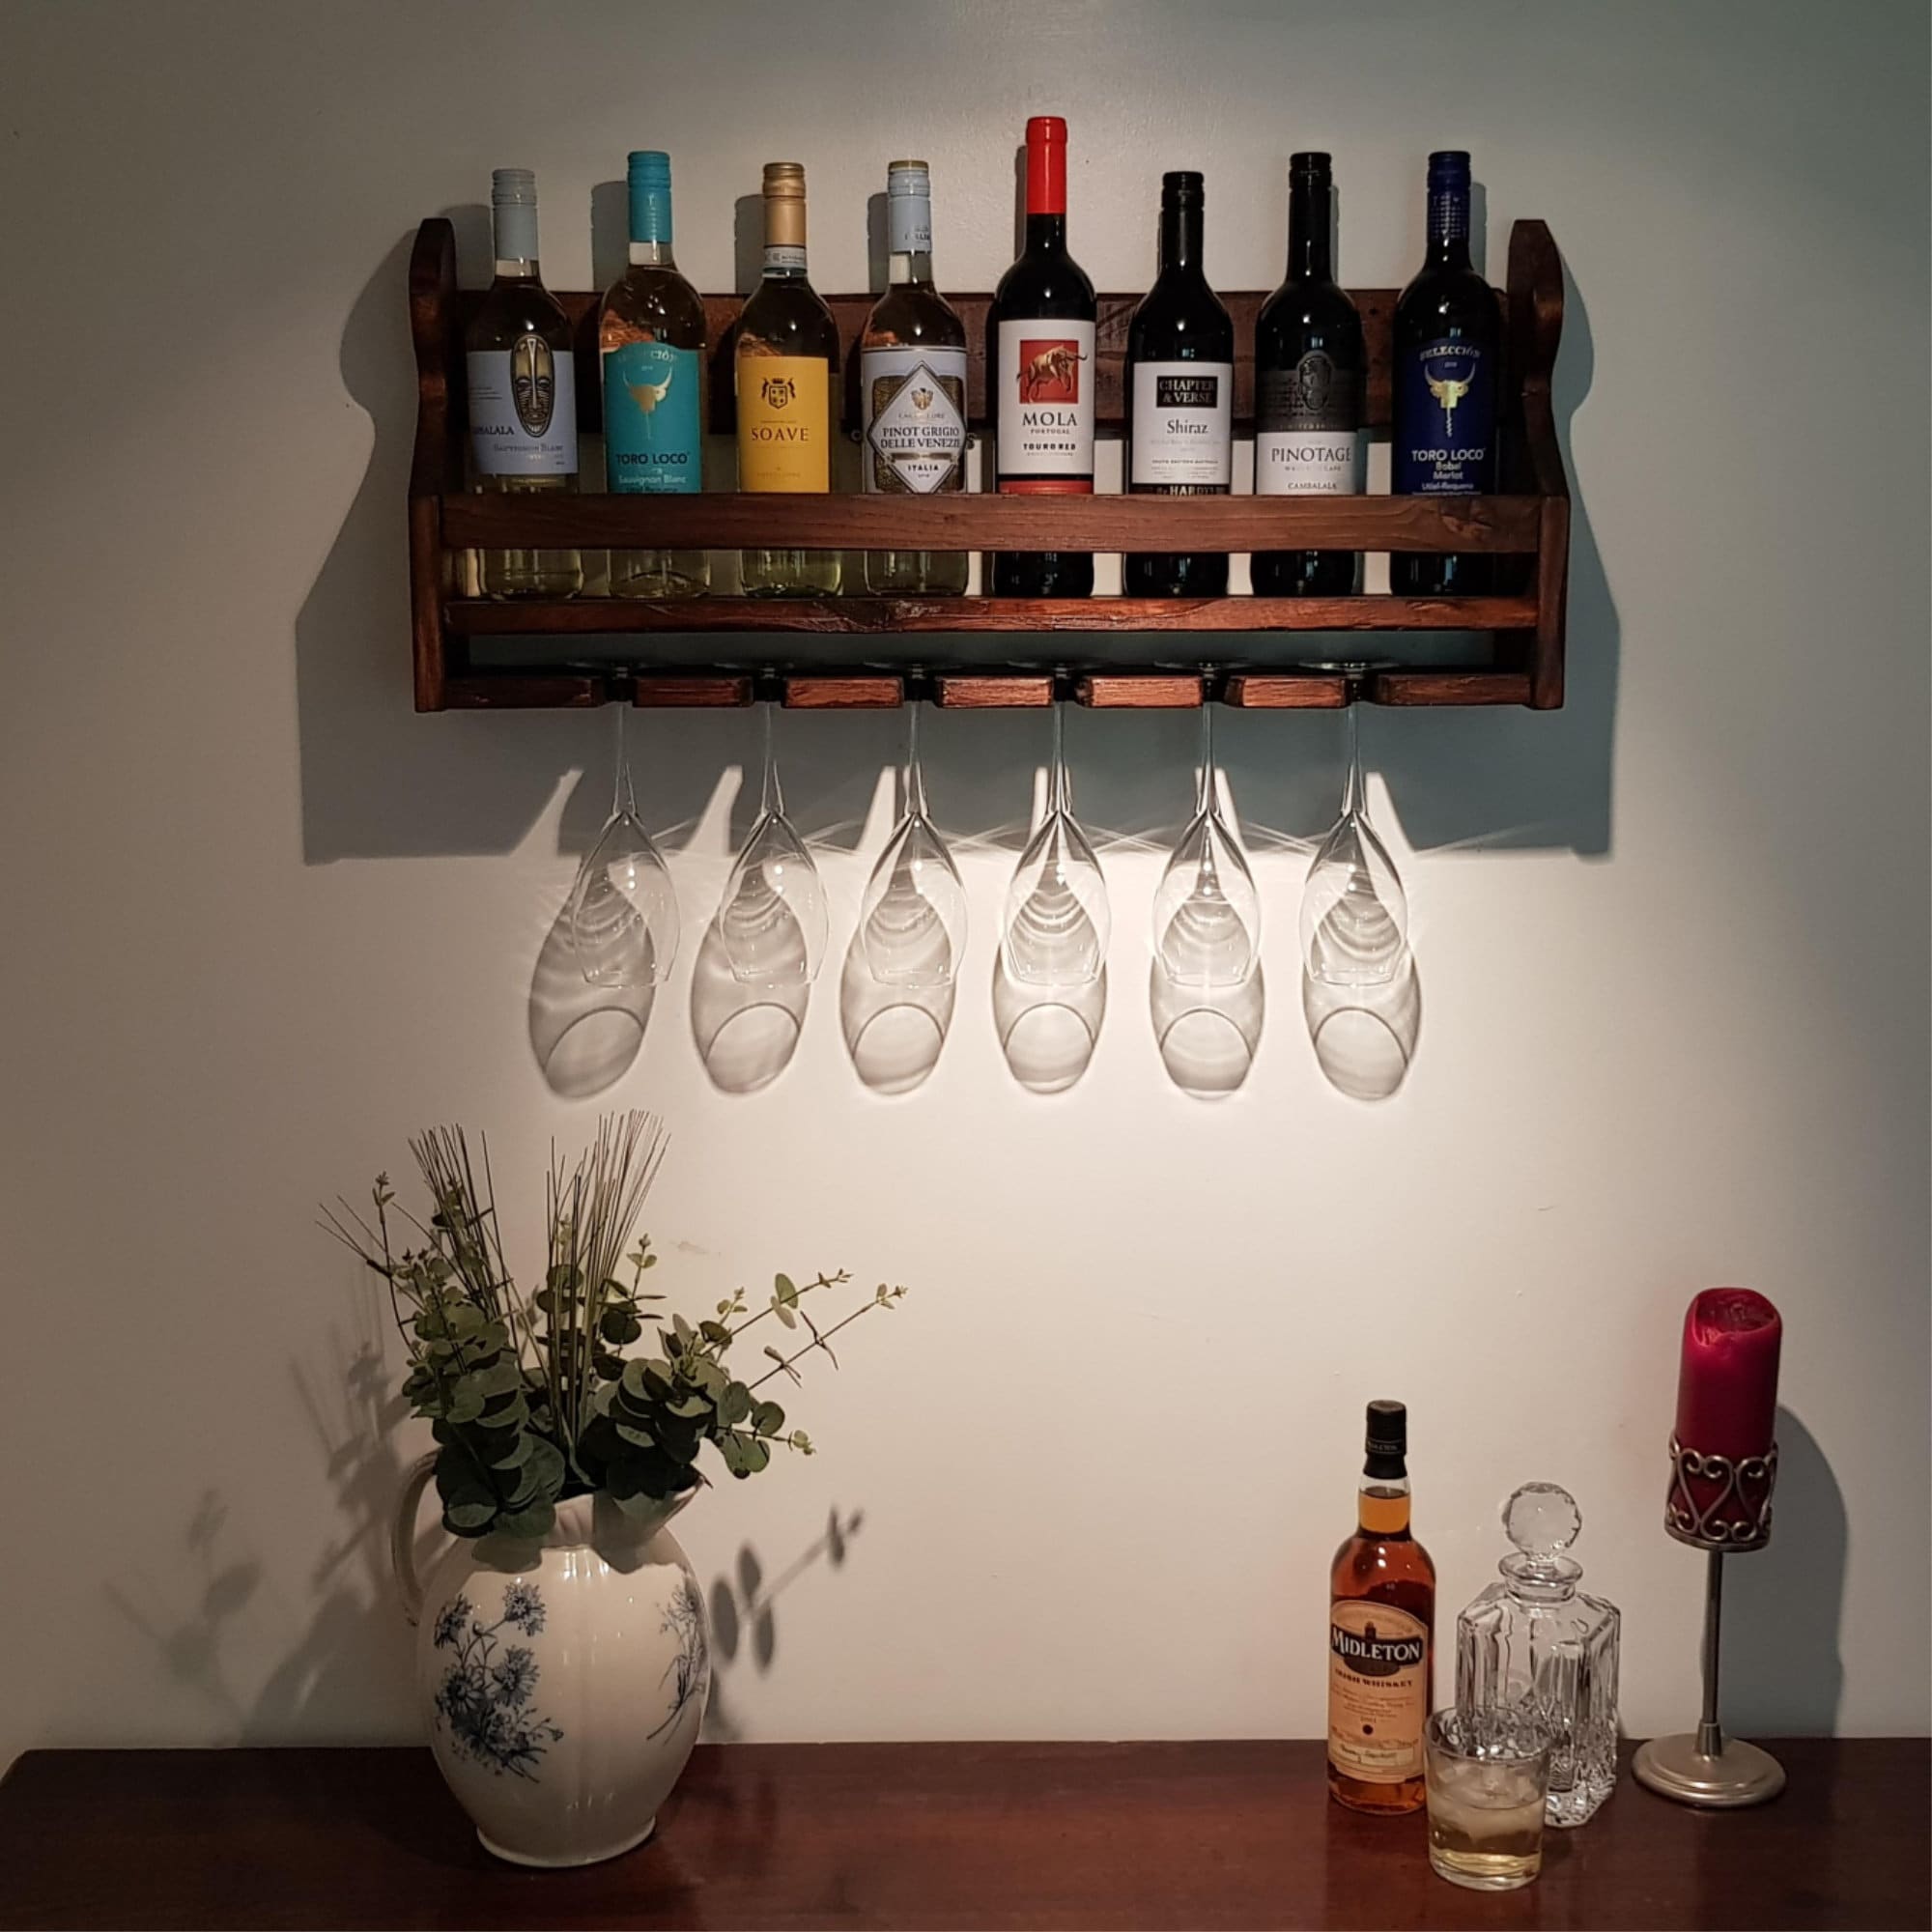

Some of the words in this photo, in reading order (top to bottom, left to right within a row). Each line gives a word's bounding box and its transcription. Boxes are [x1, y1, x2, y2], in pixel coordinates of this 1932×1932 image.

[1159, 379, 1214, 391] CHAPTER
[1163, 392, 1173, 403] &
[1174, 392, 1212, 403] VERSE
[1022, 412, 1078, 426] MOLA
[882, 427, 920, 437] PINOT
[922, 426, 959, 437] GRIGIO
[1167, 419, 1208, 434] Shiraz
[751, 427, 809, 441] SOAVE
[880, 439, 916, 448] DELLE
[616, 454, 648, 464] TORO
[652, 453, 688, 464] LOCO
[1271, 447, 1351, 462] PINOTAGE
[1411, 449, 1448, 462] TORO
[1451, 449, 1484, 461] LOCO
[1333, 1626, 1420, 1661] MIDLETON
